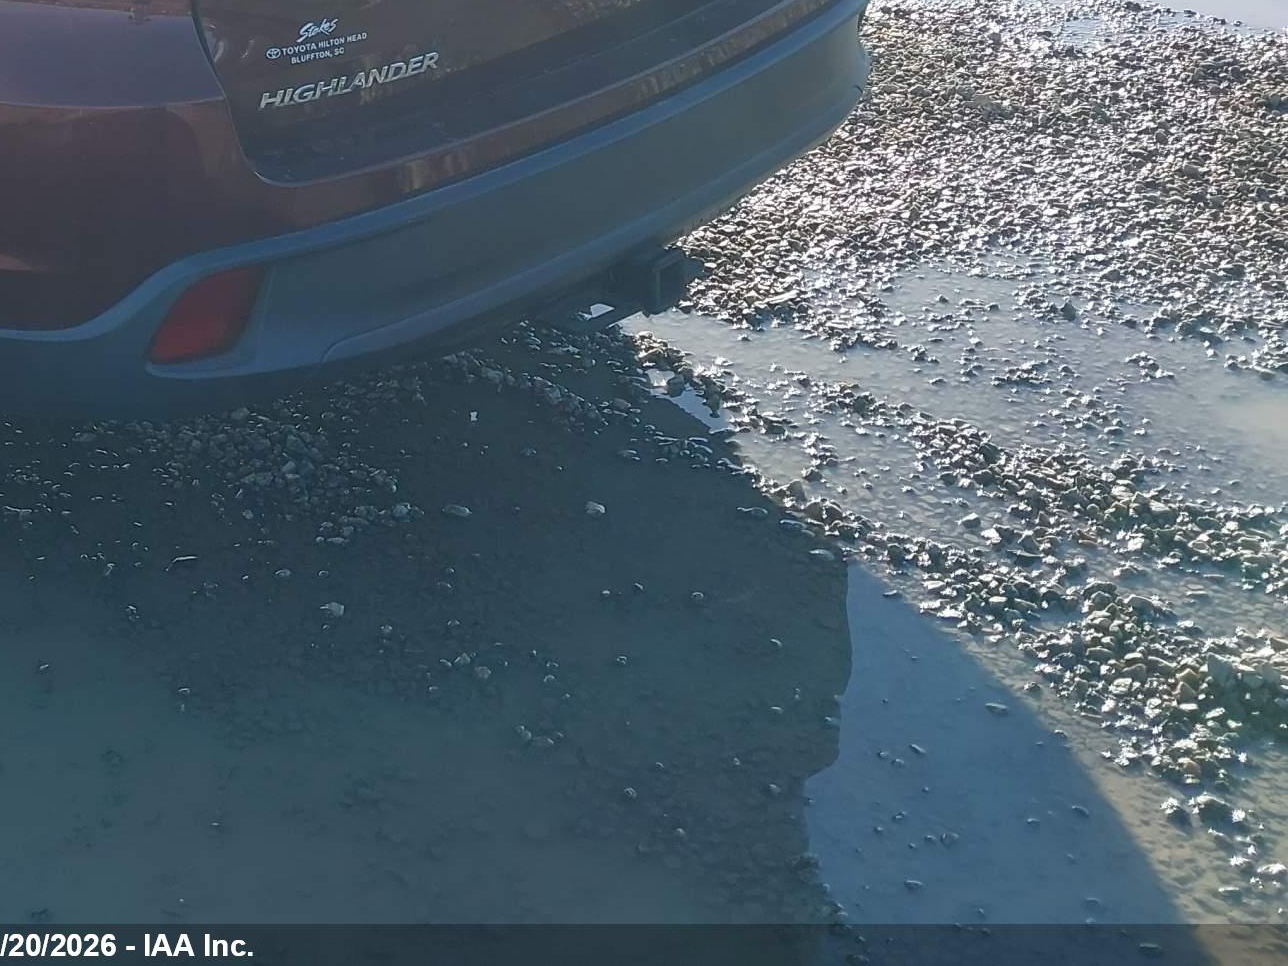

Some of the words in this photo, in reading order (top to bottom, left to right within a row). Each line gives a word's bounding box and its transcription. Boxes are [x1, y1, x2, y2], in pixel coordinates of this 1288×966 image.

[281, 42, 317, 56] TOYOTA
[318, 36, 345, 50] HILTON
[346, 32, 368, 43] HEAD
[291, 50, 332, 64] BLUFFTON,
[334, 47, 345, 56] SC
[259, 52, 440, 109] HIGHLANDER
